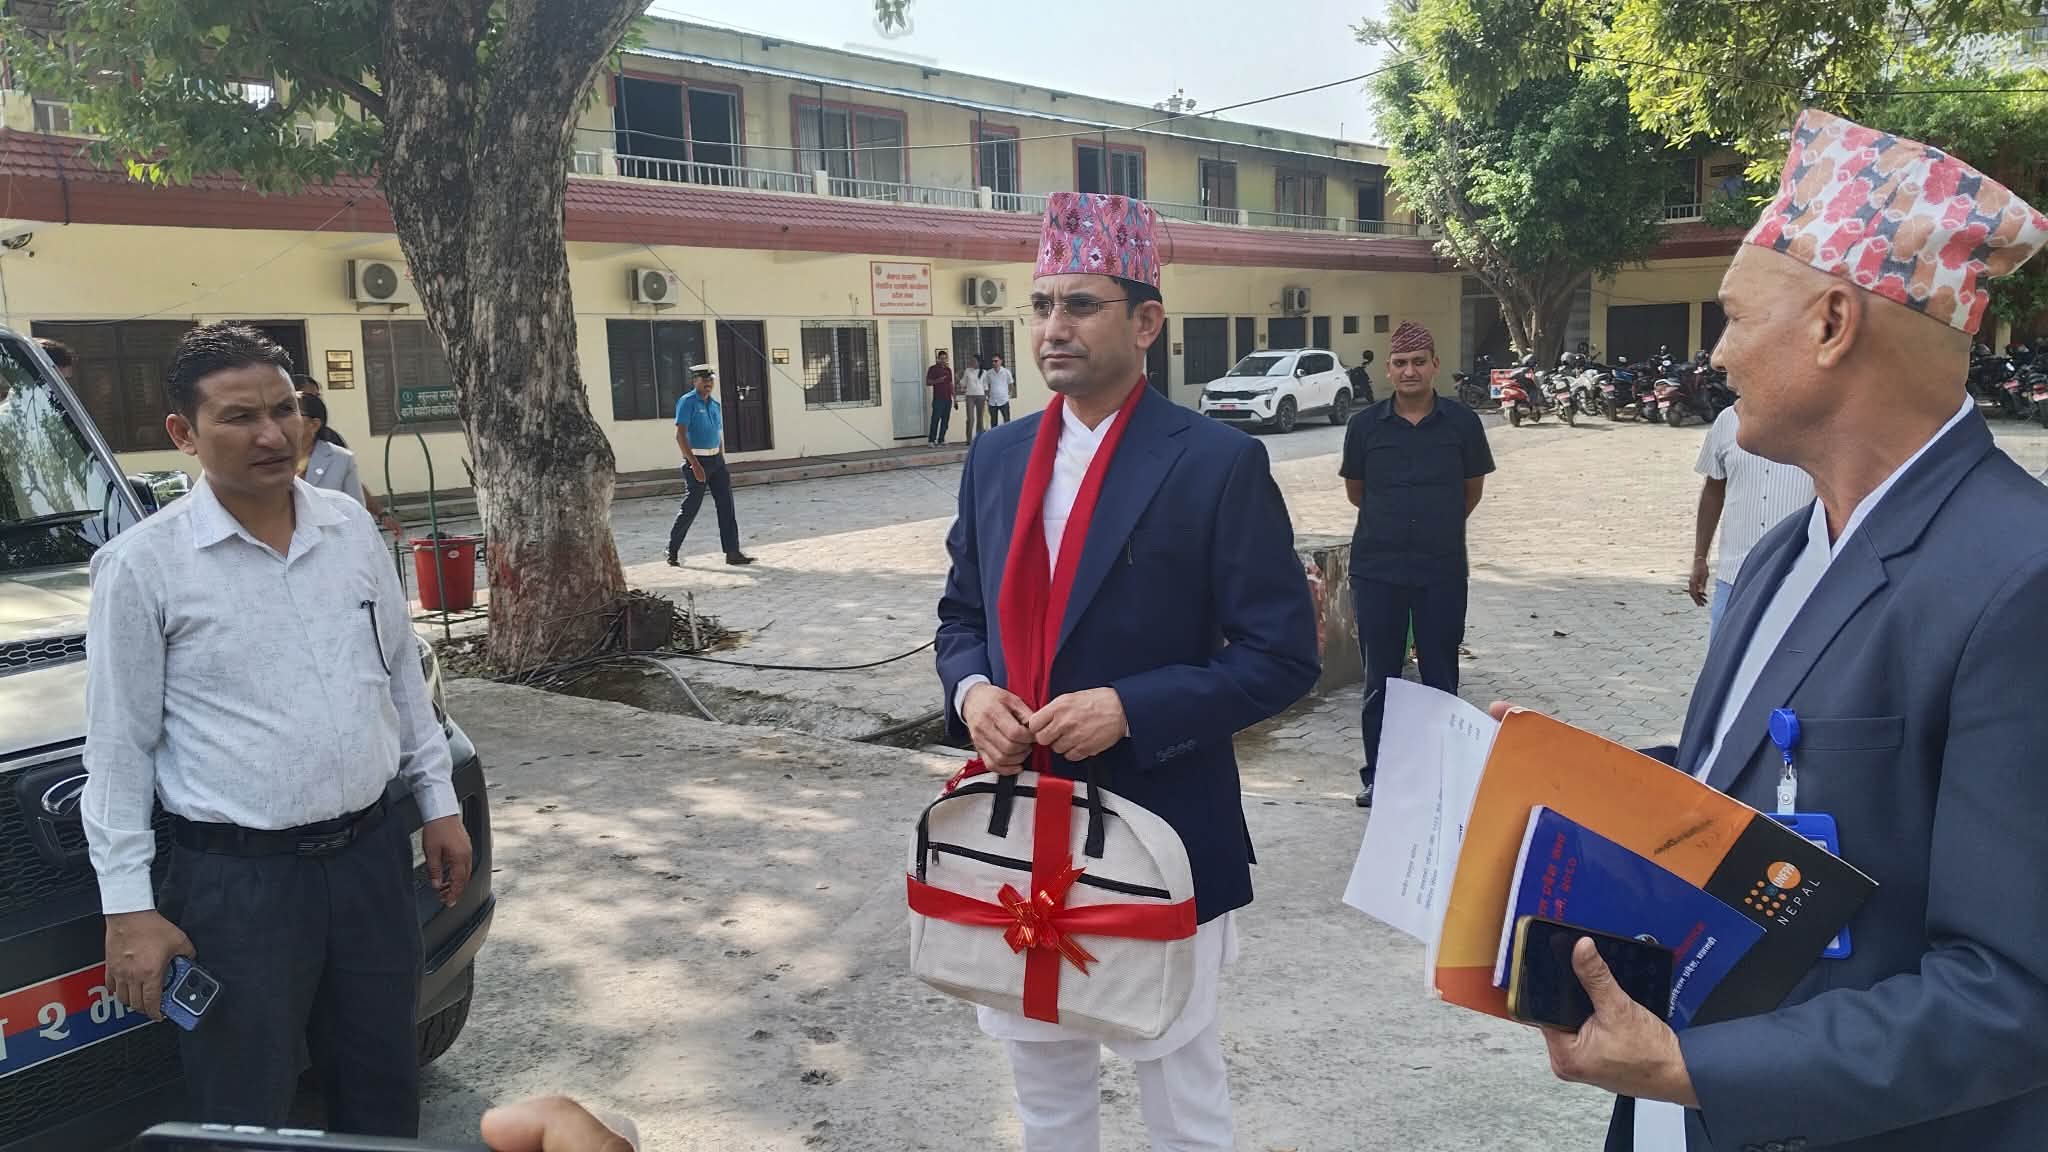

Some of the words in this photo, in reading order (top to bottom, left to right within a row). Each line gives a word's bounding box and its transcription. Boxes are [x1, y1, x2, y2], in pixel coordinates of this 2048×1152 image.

[1768, 862, 1798, 889] UNFPA
[1777, 880, 1821, 926] NEPAL
[37, 1002, 71, 1041] २
